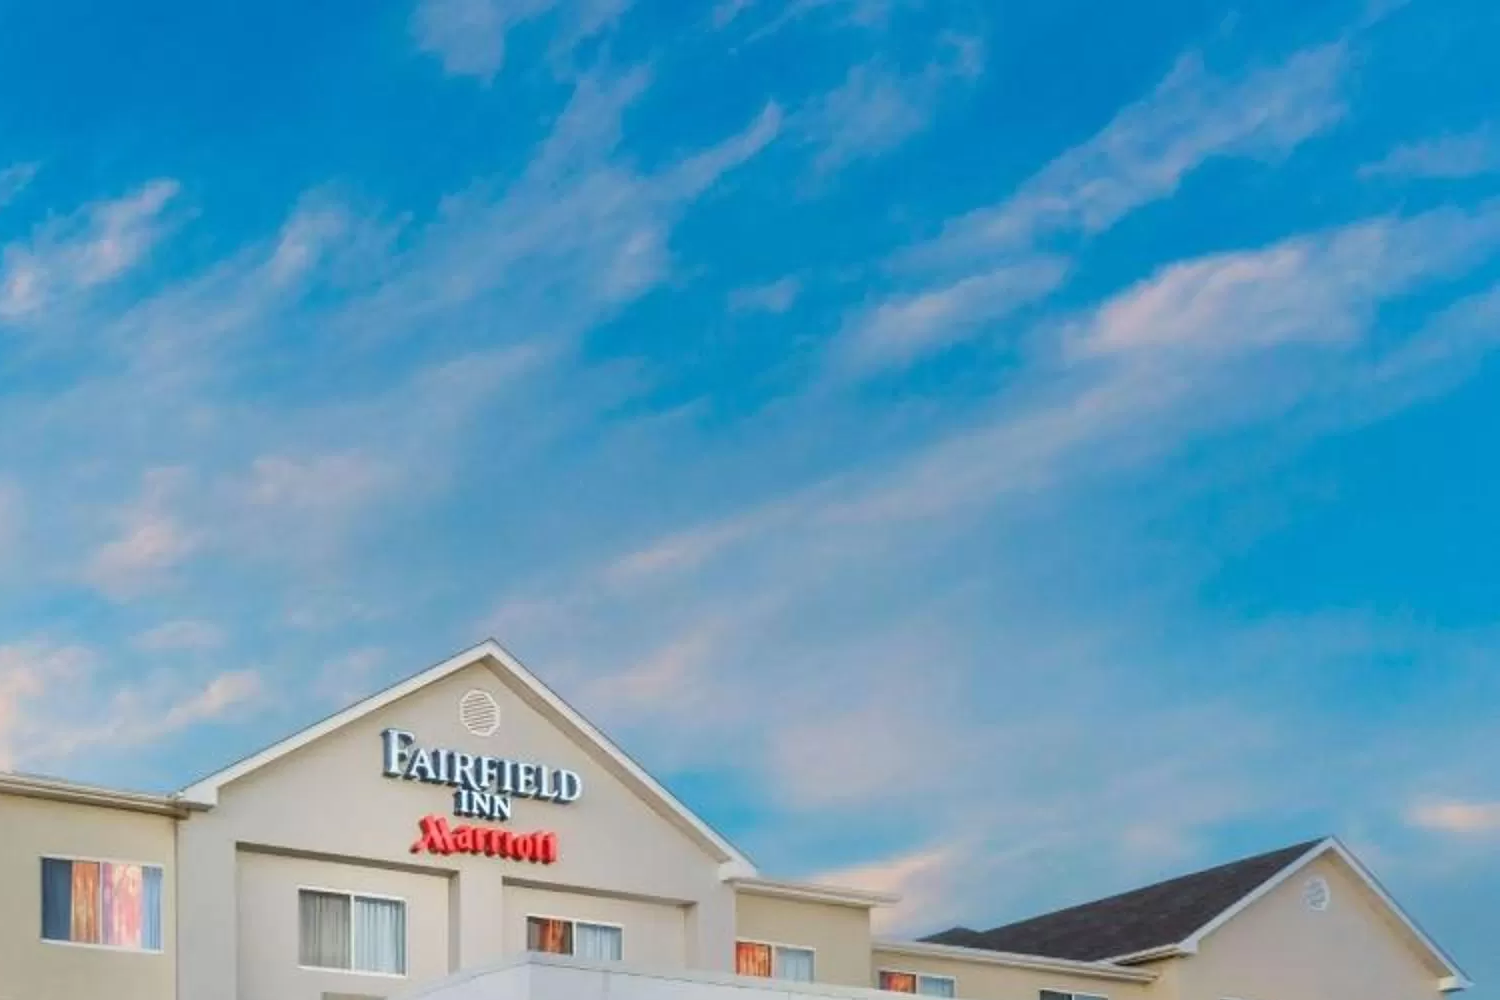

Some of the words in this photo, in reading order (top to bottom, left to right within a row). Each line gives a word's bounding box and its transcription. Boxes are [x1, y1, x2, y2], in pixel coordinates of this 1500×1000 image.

[381, 728, 582, 804] FAIRFIELD
[454, 789, 513, 820] INN
[410, 814, 559, 864] Marriott
